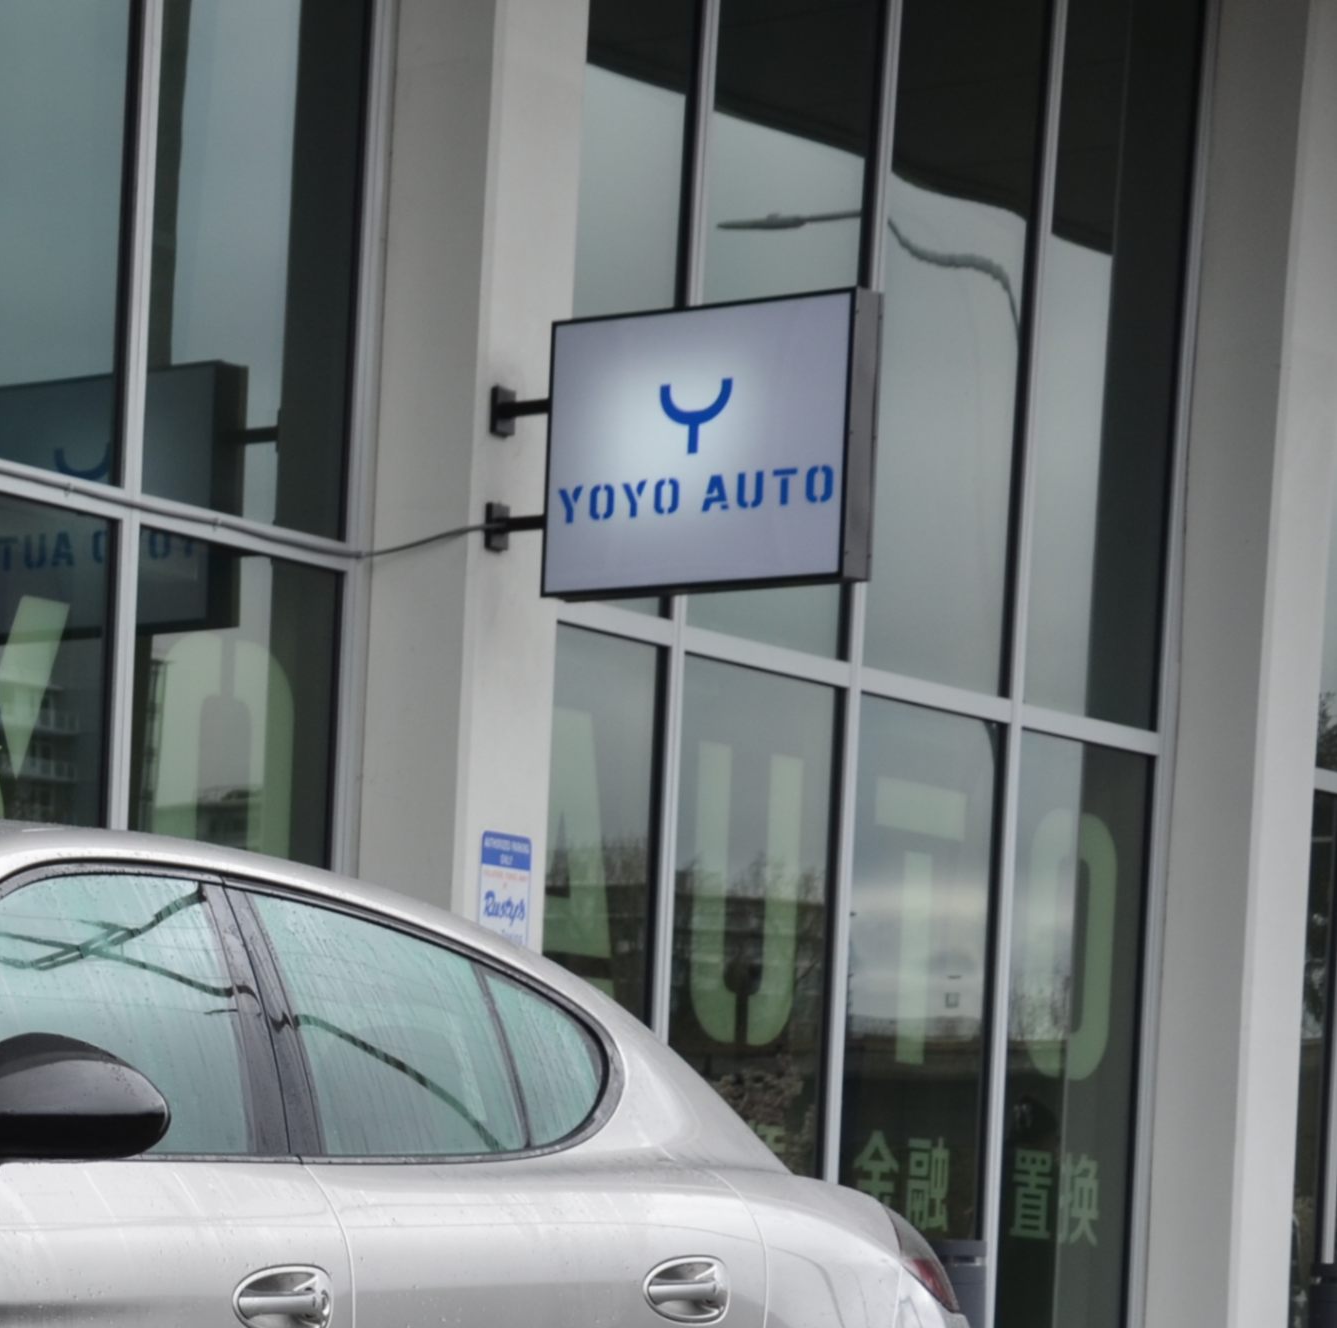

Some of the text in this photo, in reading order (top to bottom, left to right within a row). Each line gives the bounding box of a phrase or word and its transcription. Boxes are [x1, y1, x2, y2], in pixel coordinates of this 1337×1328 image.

[558, 465, 834, 524] YOYO AUTO
[483, 890, 526, 926] Rusty's
[1010, 1149, 1100, 1247] 置换
